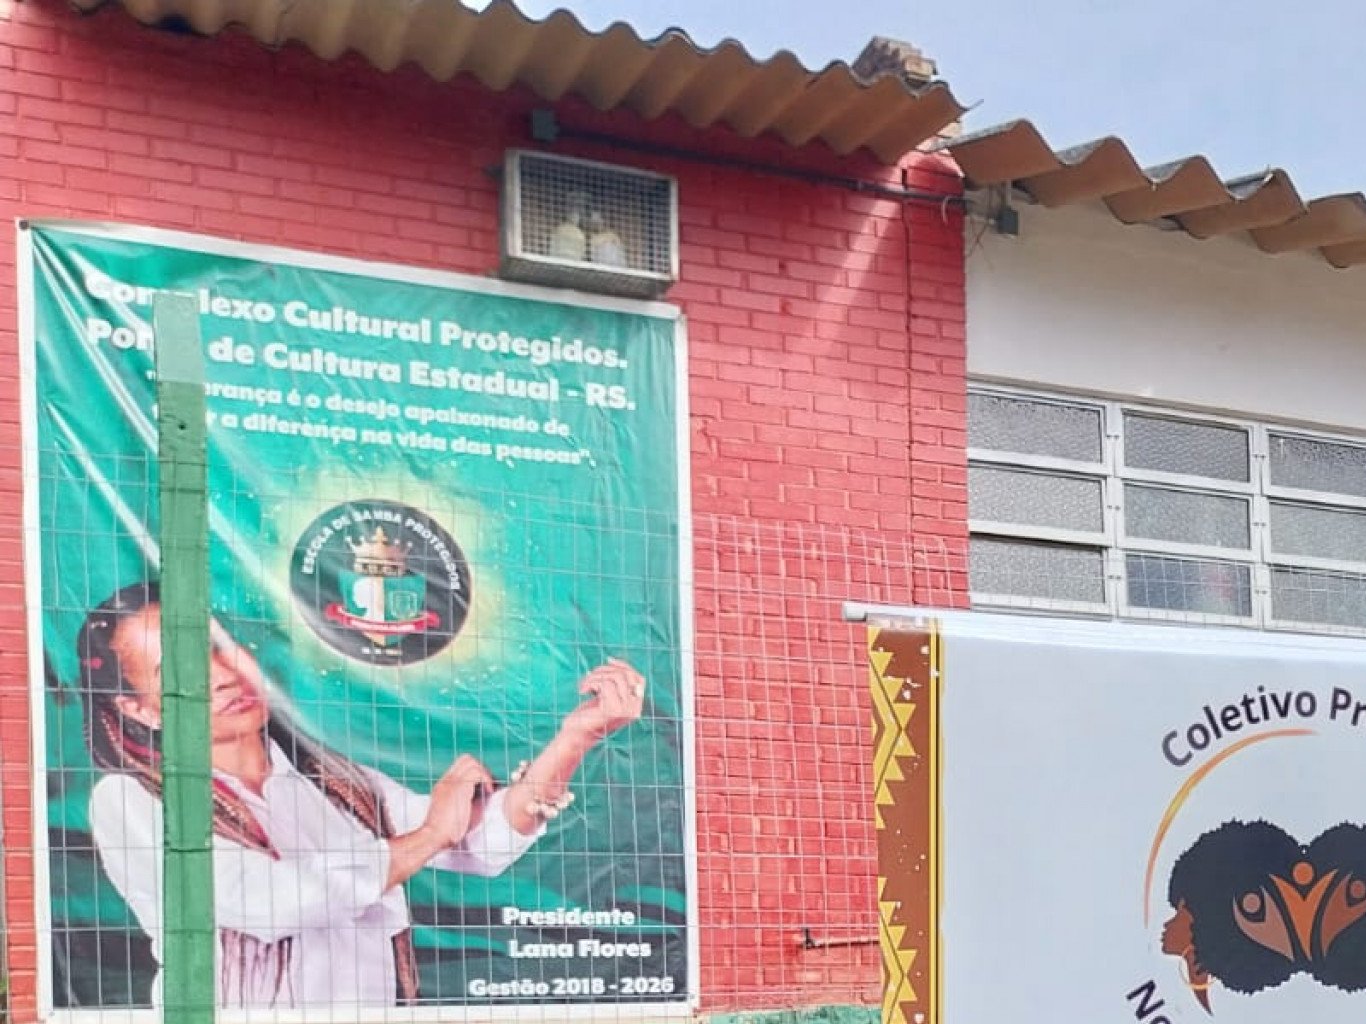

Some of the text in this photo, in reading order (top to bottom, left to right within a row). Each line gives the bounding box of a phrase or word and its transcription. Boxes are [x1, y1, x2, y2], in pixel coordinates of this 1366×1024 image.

[84, 271, 628, 369] Colexo Cultural Protegidos.
[208, 337, 256, 364] de
[263, 342, 401, 384] Cultura
[409, 360, 559, 401] Estadual
[586, 382, 636, 411] RS.
[221, 412, 238, 428] a
[242, 411, 357, 444] diferença
[361, 427, 392, 446] na
[397, 430, 447, 452] vida
[450, 436, 493, 456] das
[287, 386, 300, 407] é
[302, 392, 320, 408] o
[324, 390, 400, 420] desejo
[404, 404, 540, 433] apaixonado
[544, 419, 571, 438] de
[302, 526, 334, 575] ESCOLA
[1162, 685, 1318, 768] Coletivo
[501, 906, 635, 926] Presidente
[508, 938, 651, 959] Lana Flores
[468, 978, 550, 997] Gestão
[553, 976, 605, 995] 2018
[621, 976, 675, 994] 2026
